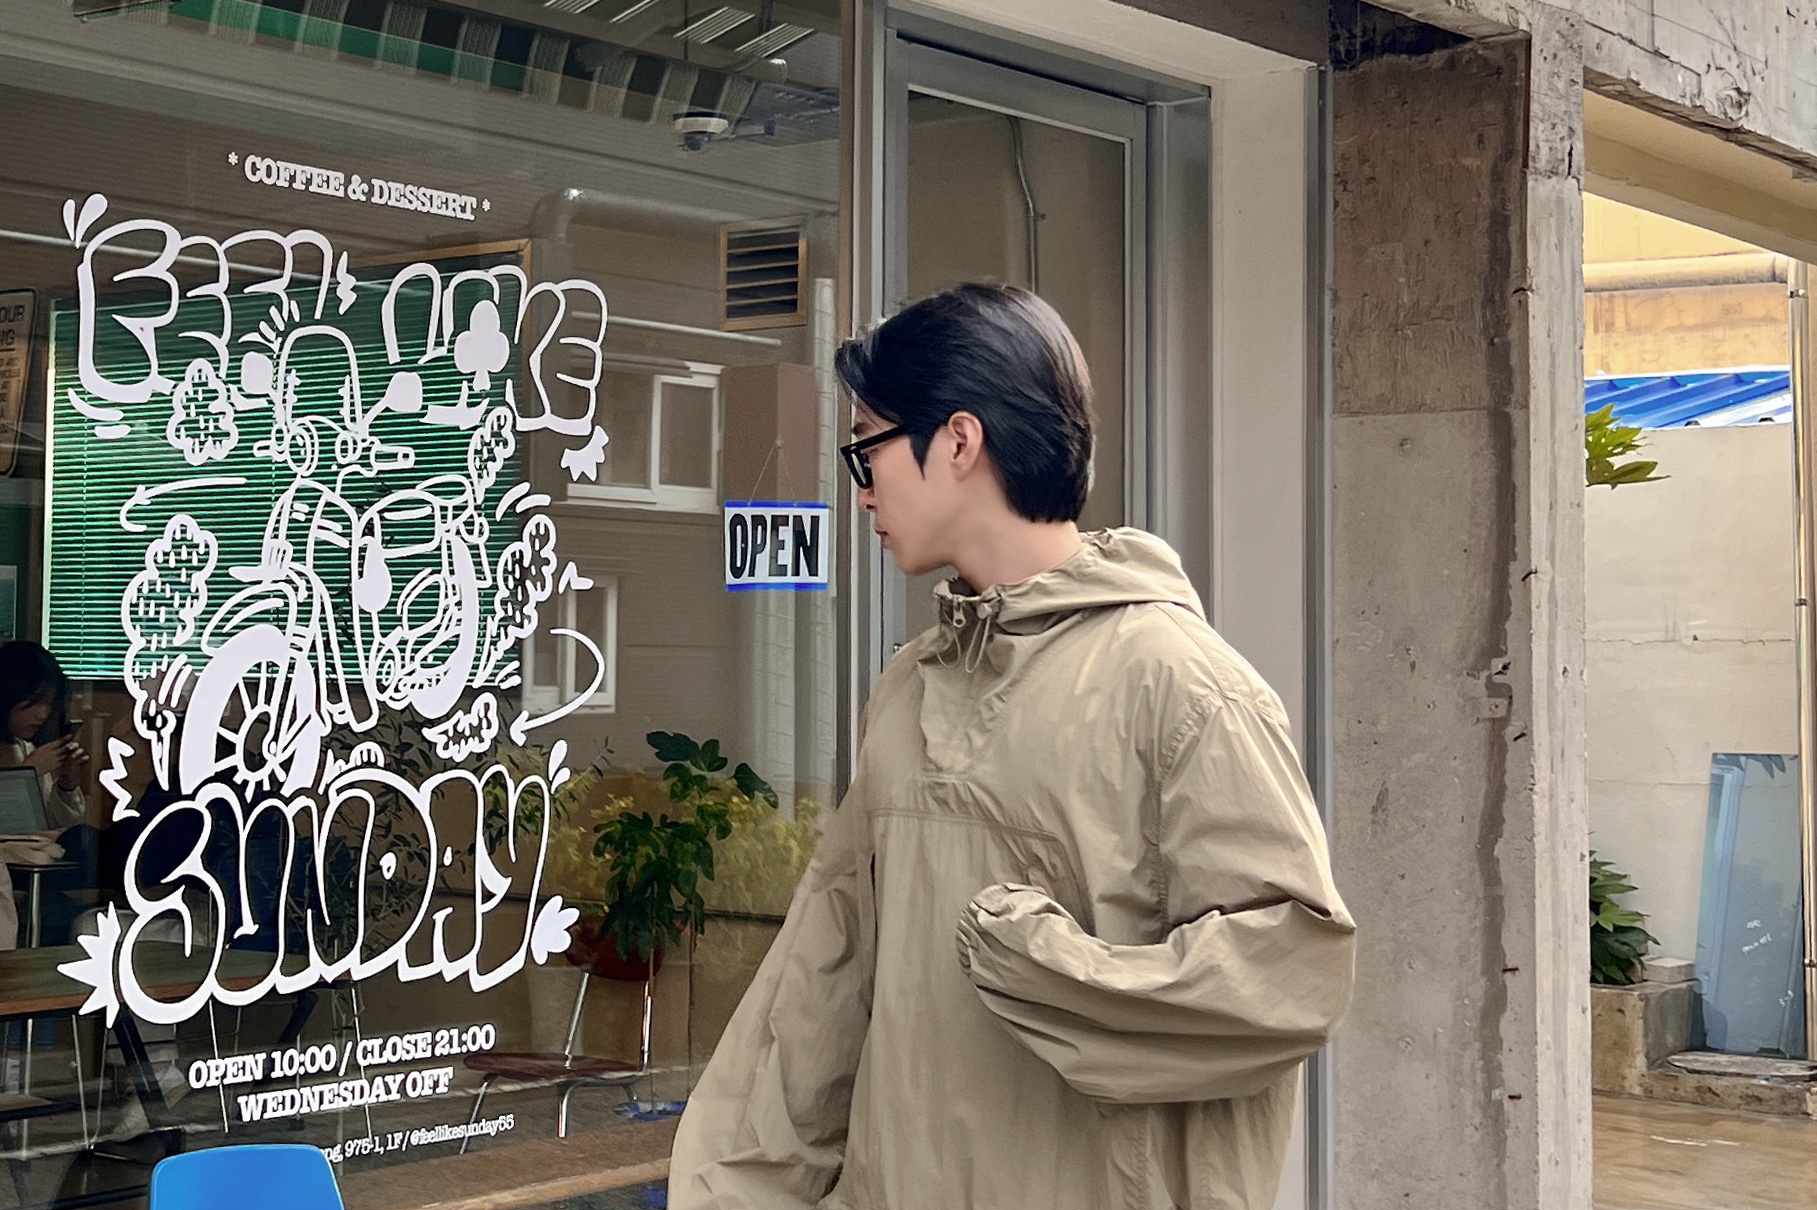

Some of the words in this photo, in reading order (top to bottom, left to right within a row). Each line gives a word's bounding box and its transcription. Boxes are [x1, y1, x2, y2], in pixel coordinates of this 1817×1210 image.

[244, 154, 345, 198] COFFEE
[347, 174, 368, 201] &
[370, 178, 478, 220] DESSERT
[729, 513, 820, 579] OPEN
[118, 762, 551, 1026] SUNDAY
[188, 1052, 266, 1090] OPEN
[271, 1045, 337, 1079] 10:00
[356, 1031, 433, 1067] CLOSE
[434, 1023, 497, 1055] 21:00
[237, 1072, 406, 1122] WEDNESDAY
[405, 1066, 455, 1098] OFF
